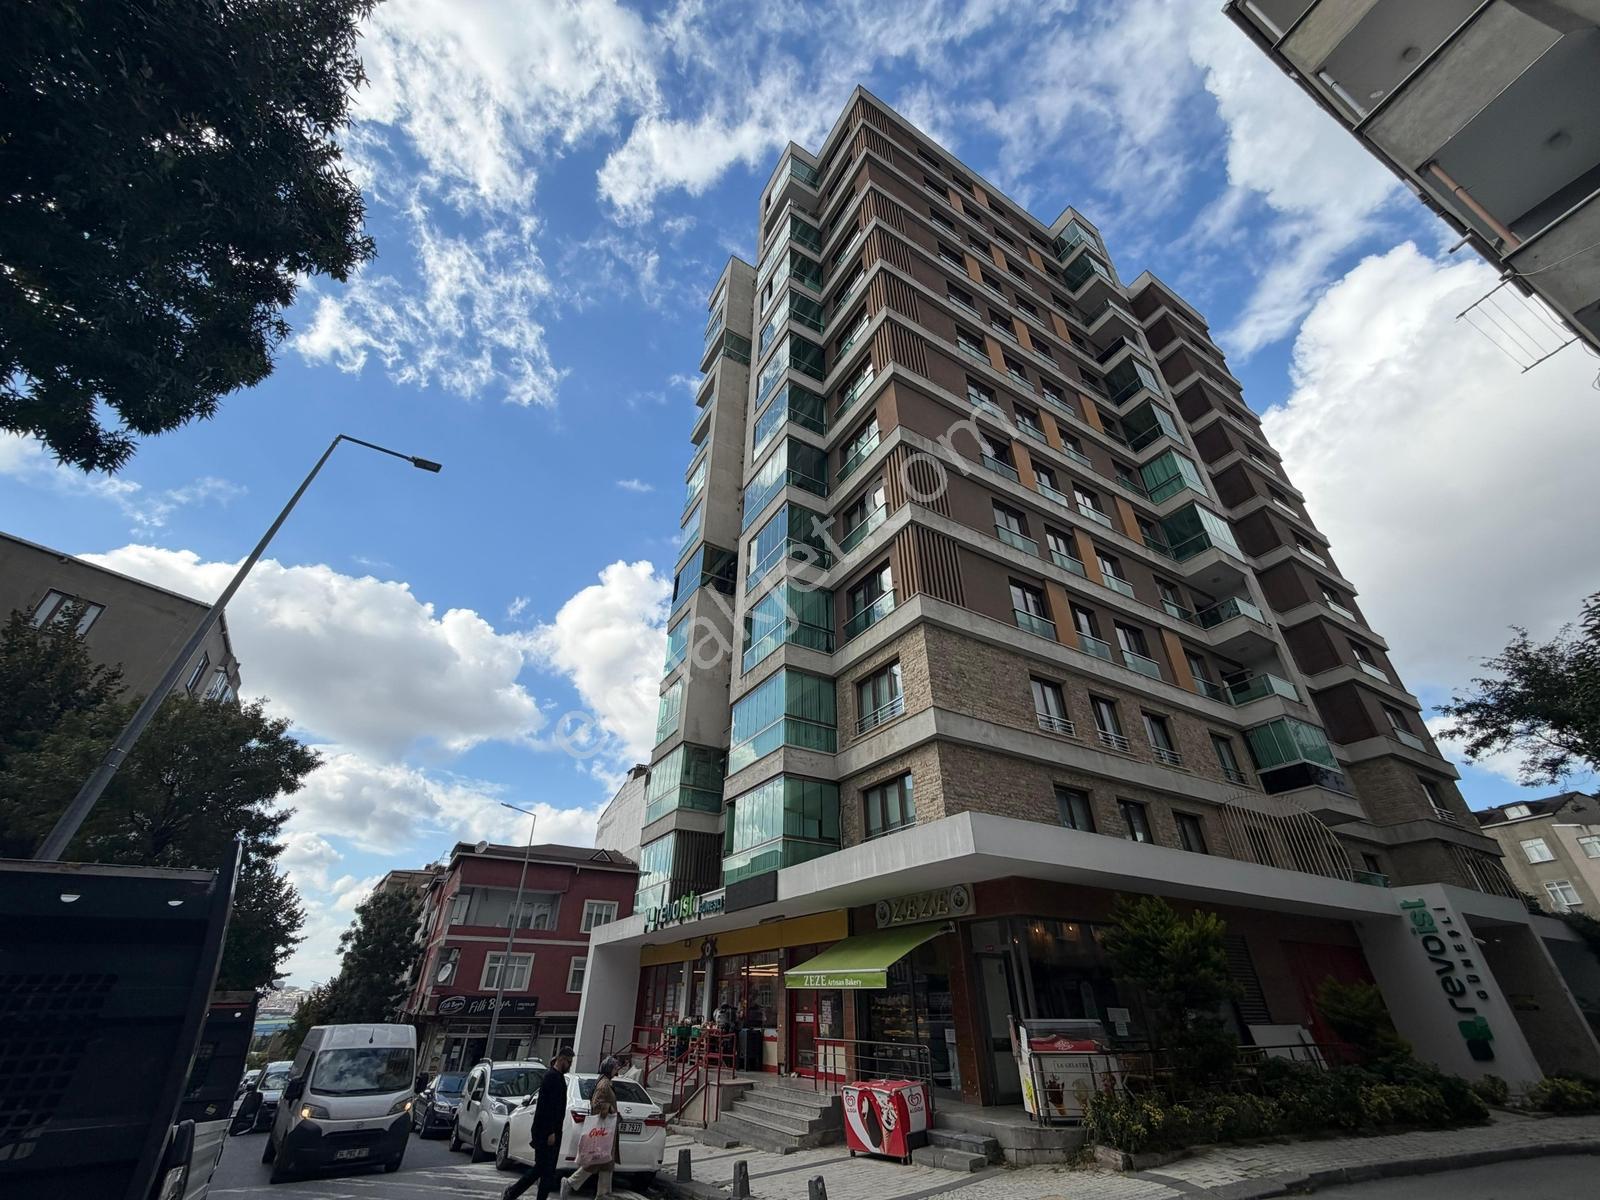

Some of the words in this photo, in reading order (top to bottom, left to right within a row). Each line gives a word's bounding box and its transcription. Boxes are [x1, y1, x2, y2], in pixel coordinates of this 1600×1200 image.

[891, 890, 949, 923] ZEZE
[1399, 898, 1477, 1015] revoist
[803, 975, 827, 987] ZEZE
[845, 978, 862, 988] Bakery
[468, 998, 488, 1014] Filli
[488, 997, 511, 1012] Bya
